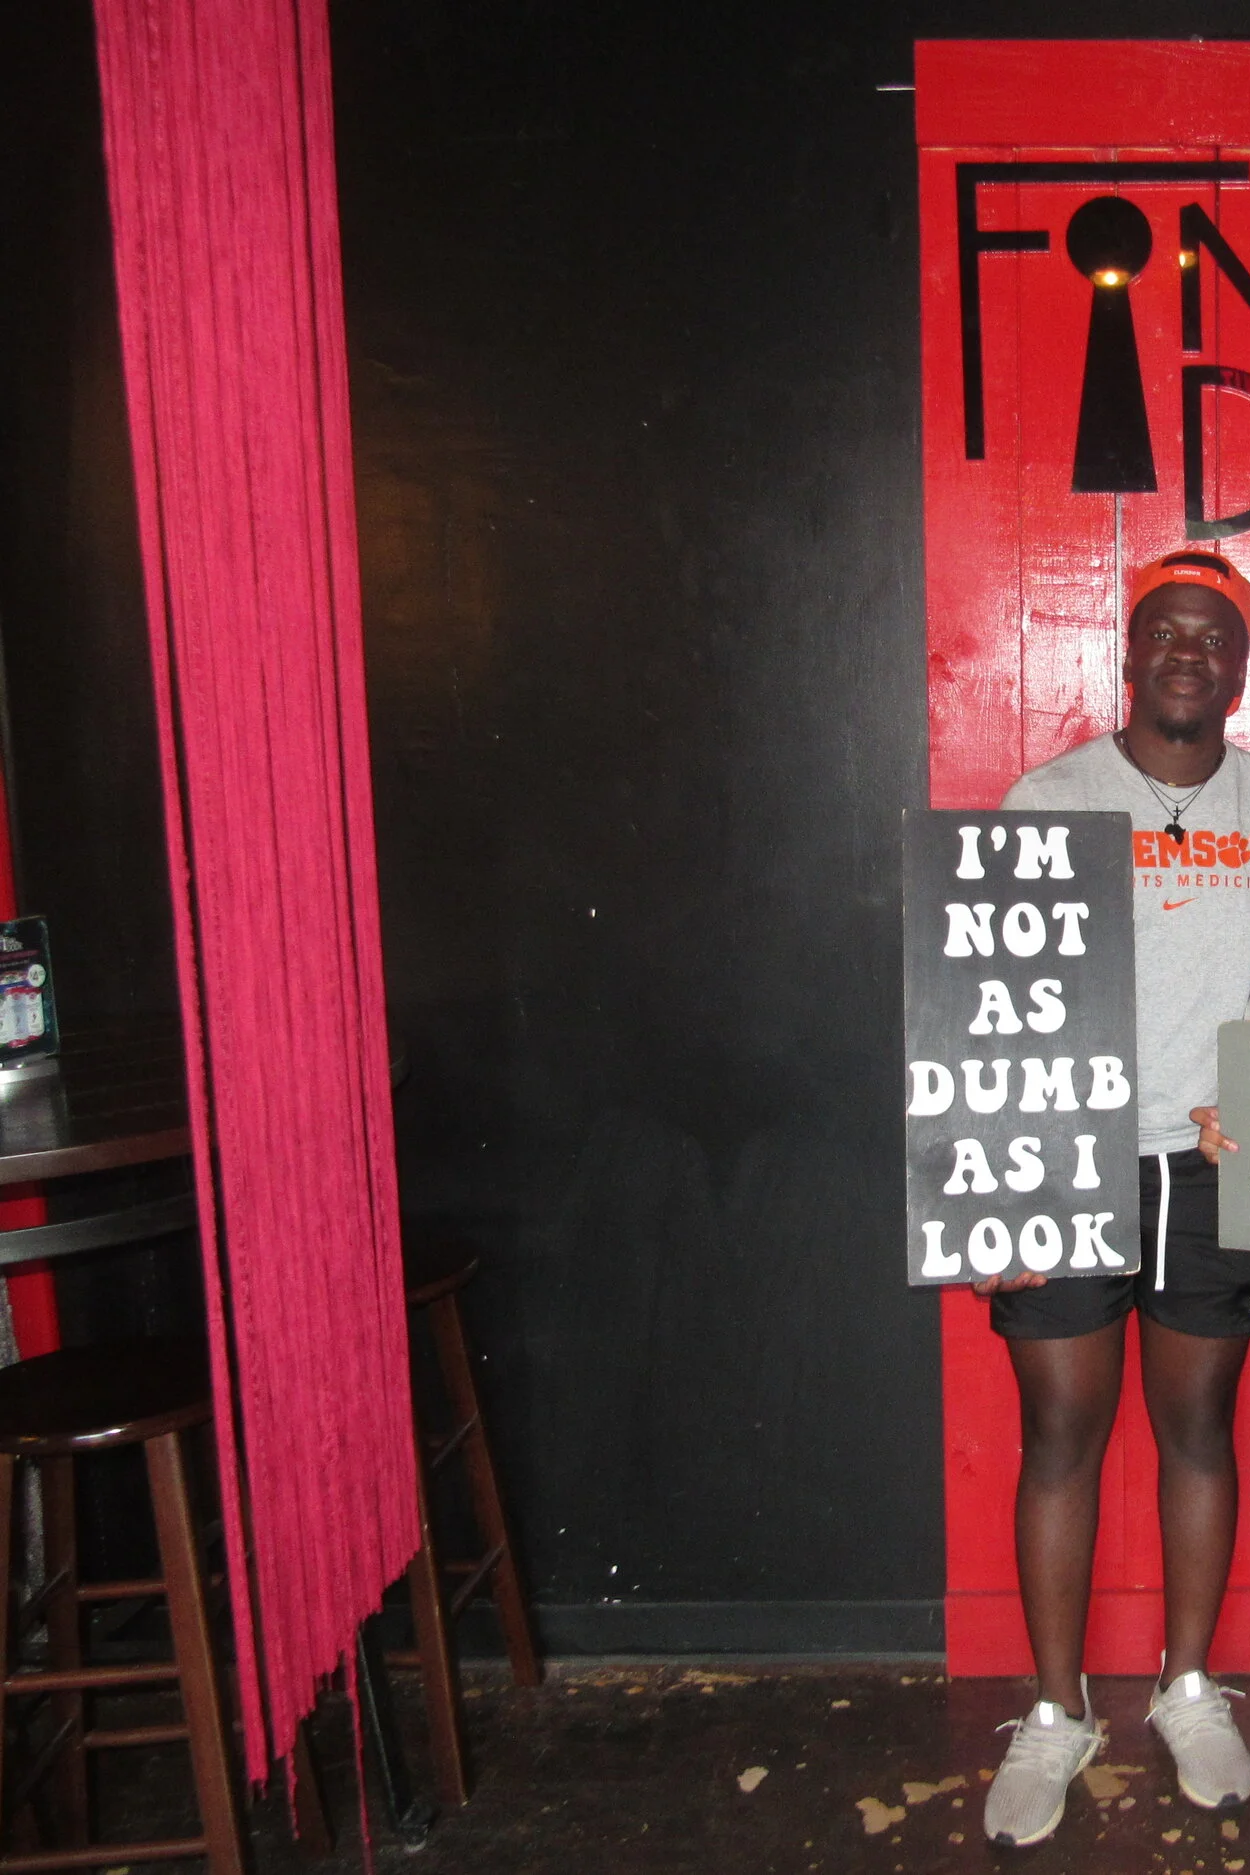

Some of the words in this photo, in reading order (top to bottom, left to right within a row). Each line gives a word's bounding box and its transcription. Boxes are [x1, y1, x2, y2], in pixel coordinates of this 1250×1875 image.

[956, 825, 1075, 880] I'M
[943, 902, 1089, 957] NOT
[968, 978, 1067, 1035] AS
[907, 1055, 1131, 1117] DUMB
[943, 1136, 1046, 1195] AS
[1071, 1134, 1101, 1190] I
[921, 1211, 1126, 1277] LOOK
